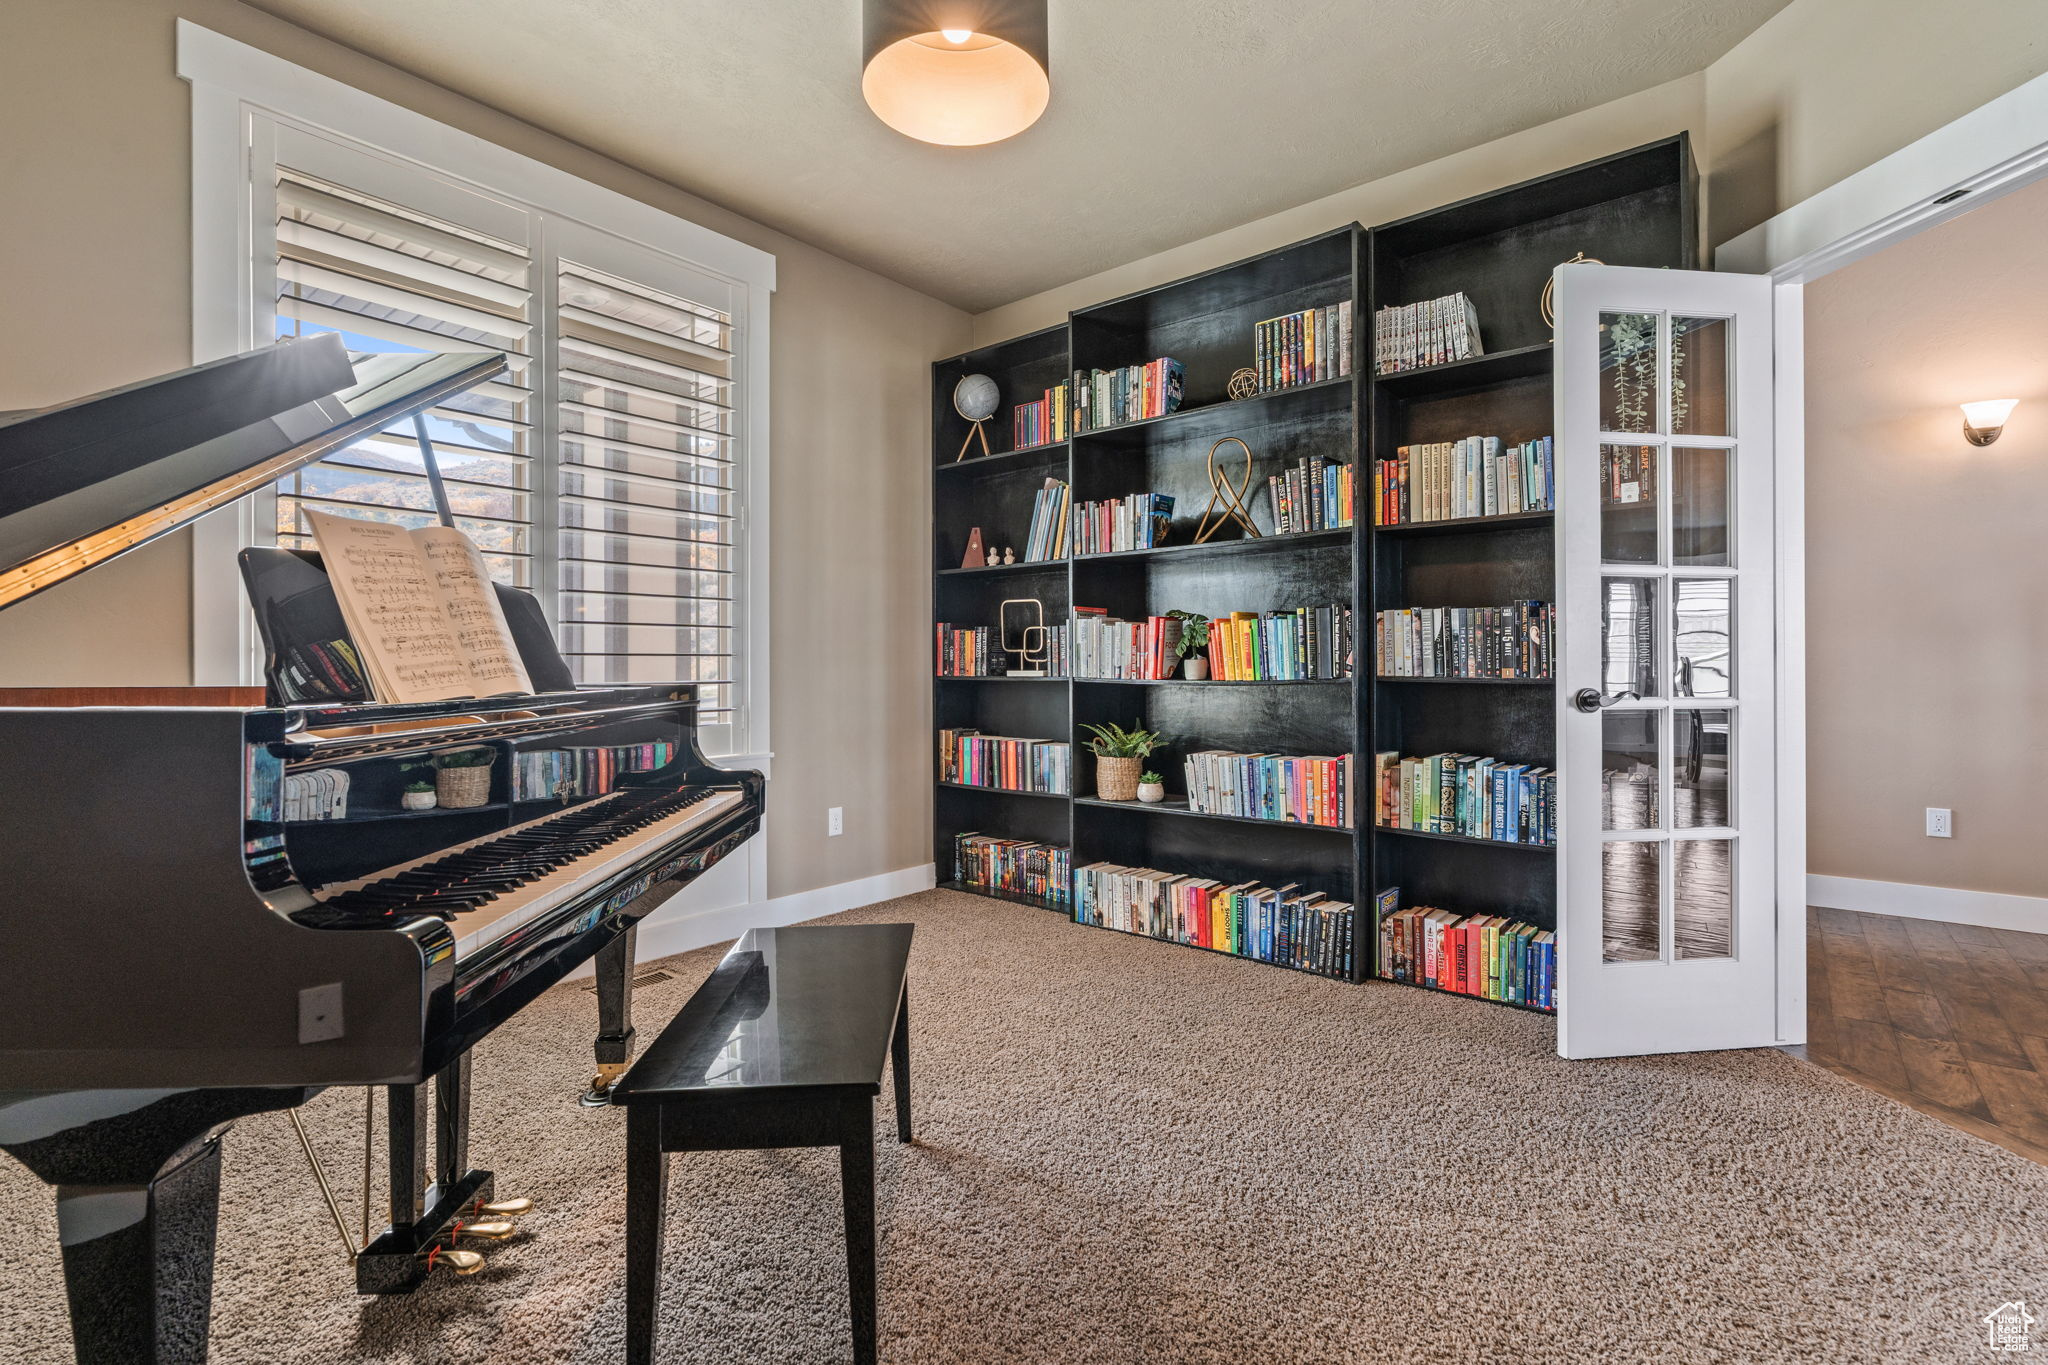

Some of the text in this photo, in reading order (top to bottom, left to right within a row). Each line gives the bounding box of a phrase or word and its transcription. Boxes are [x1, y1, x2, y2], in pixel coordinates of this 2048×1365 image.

[1423, 642, 1431, 658] BENT
[1639, 616, 1650, 666] NINTH HOUSE
